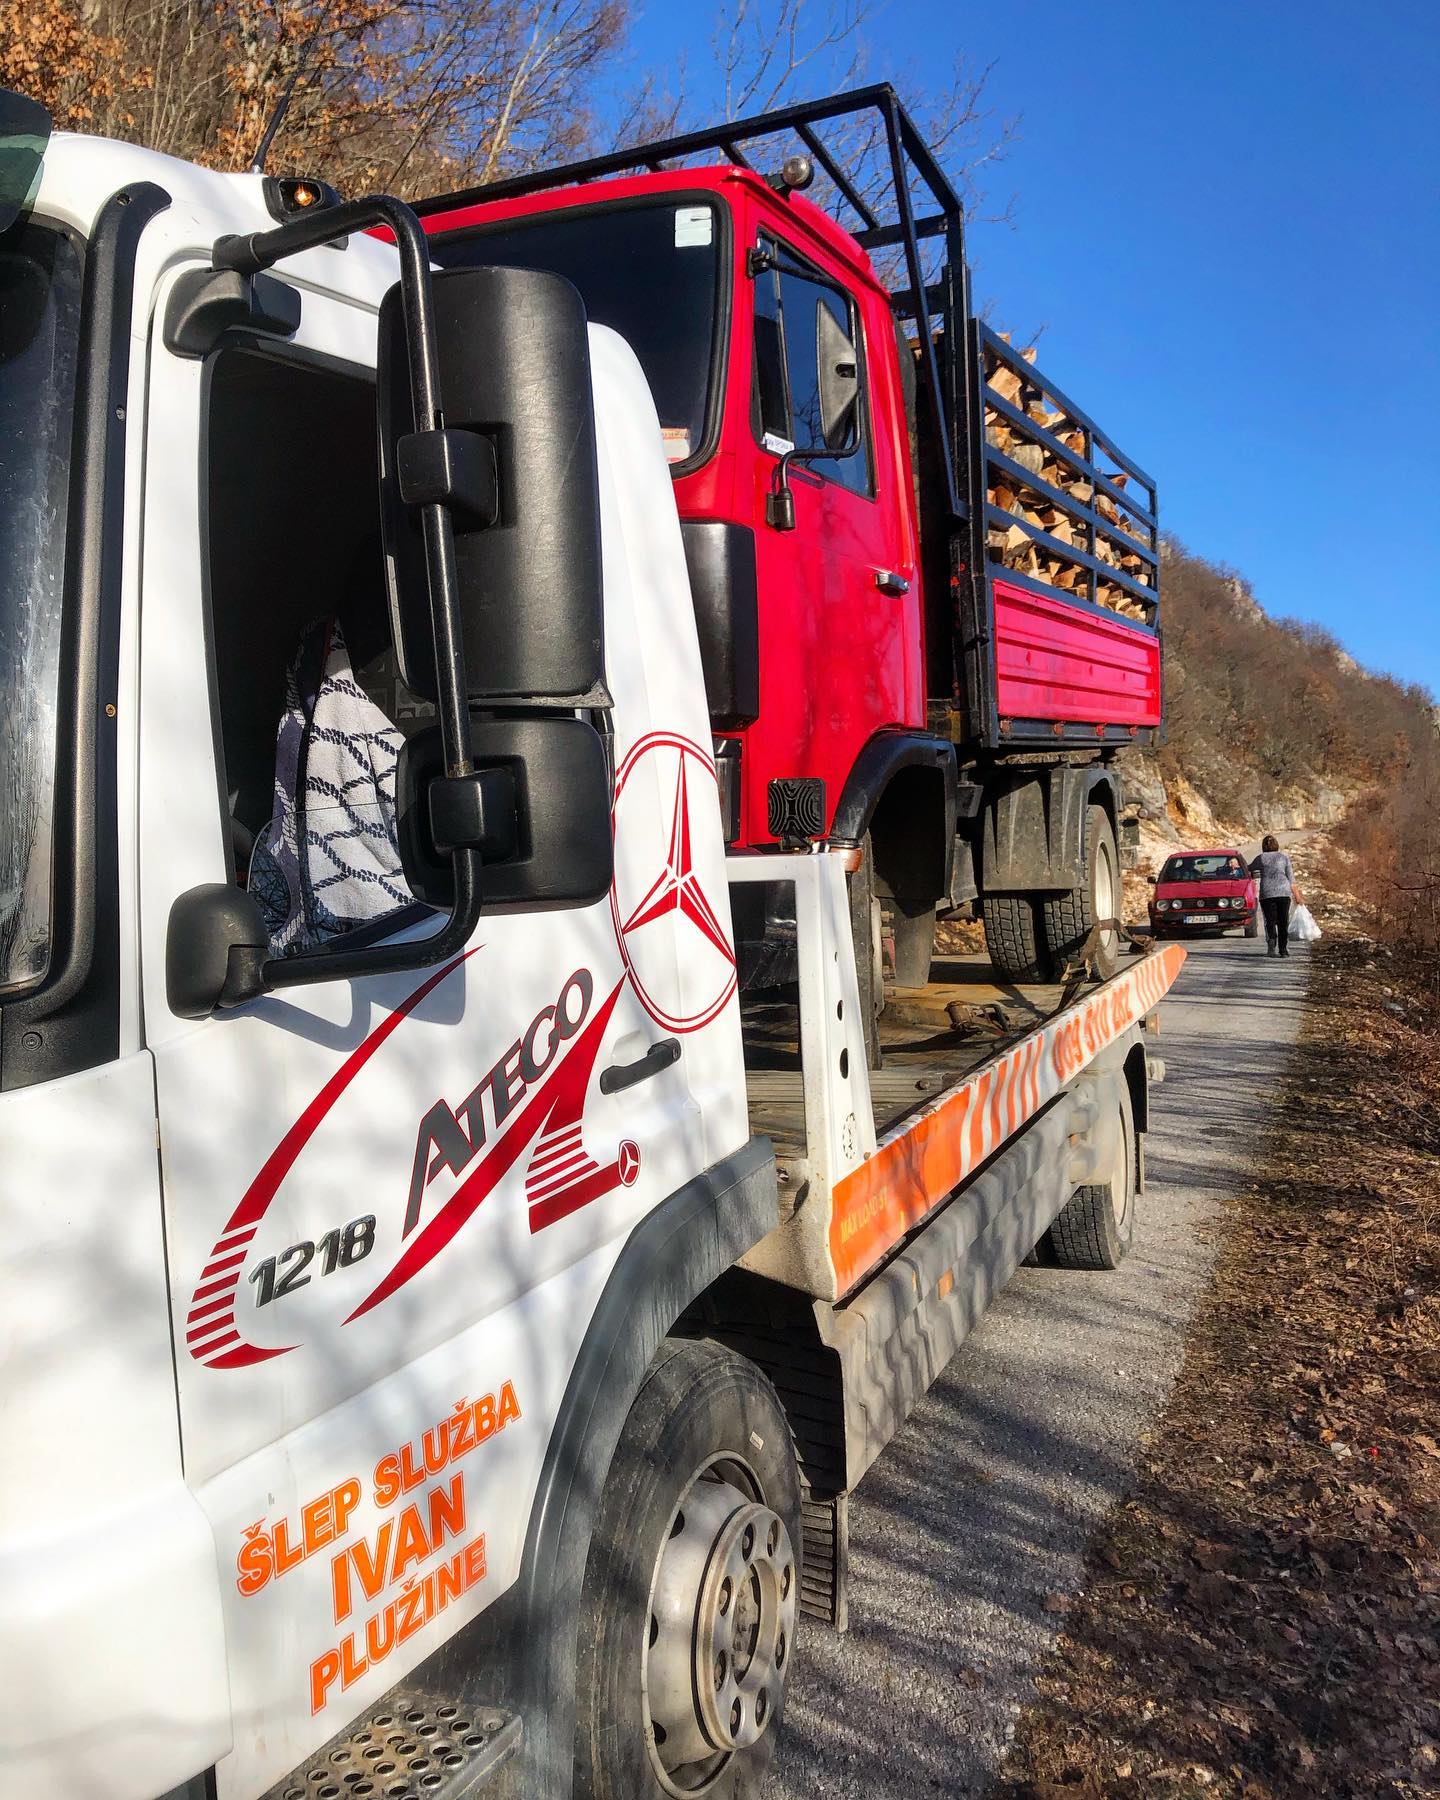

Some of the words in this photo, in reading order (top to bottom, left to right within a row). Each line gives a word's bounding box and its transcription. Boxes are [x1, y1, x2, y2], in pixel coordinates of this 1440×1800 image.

[401, 968, 594, 1243] ATEGO
[248, 1214, 376, 1308] 1218
[236, 1477, 361, 1597] ŠLEP
[372, 1380, 522, 1509] SLUŽBA
[330, 1470, 466, 1626] IVAN
[311, 1533, 487, 1717] PLUŽINE
